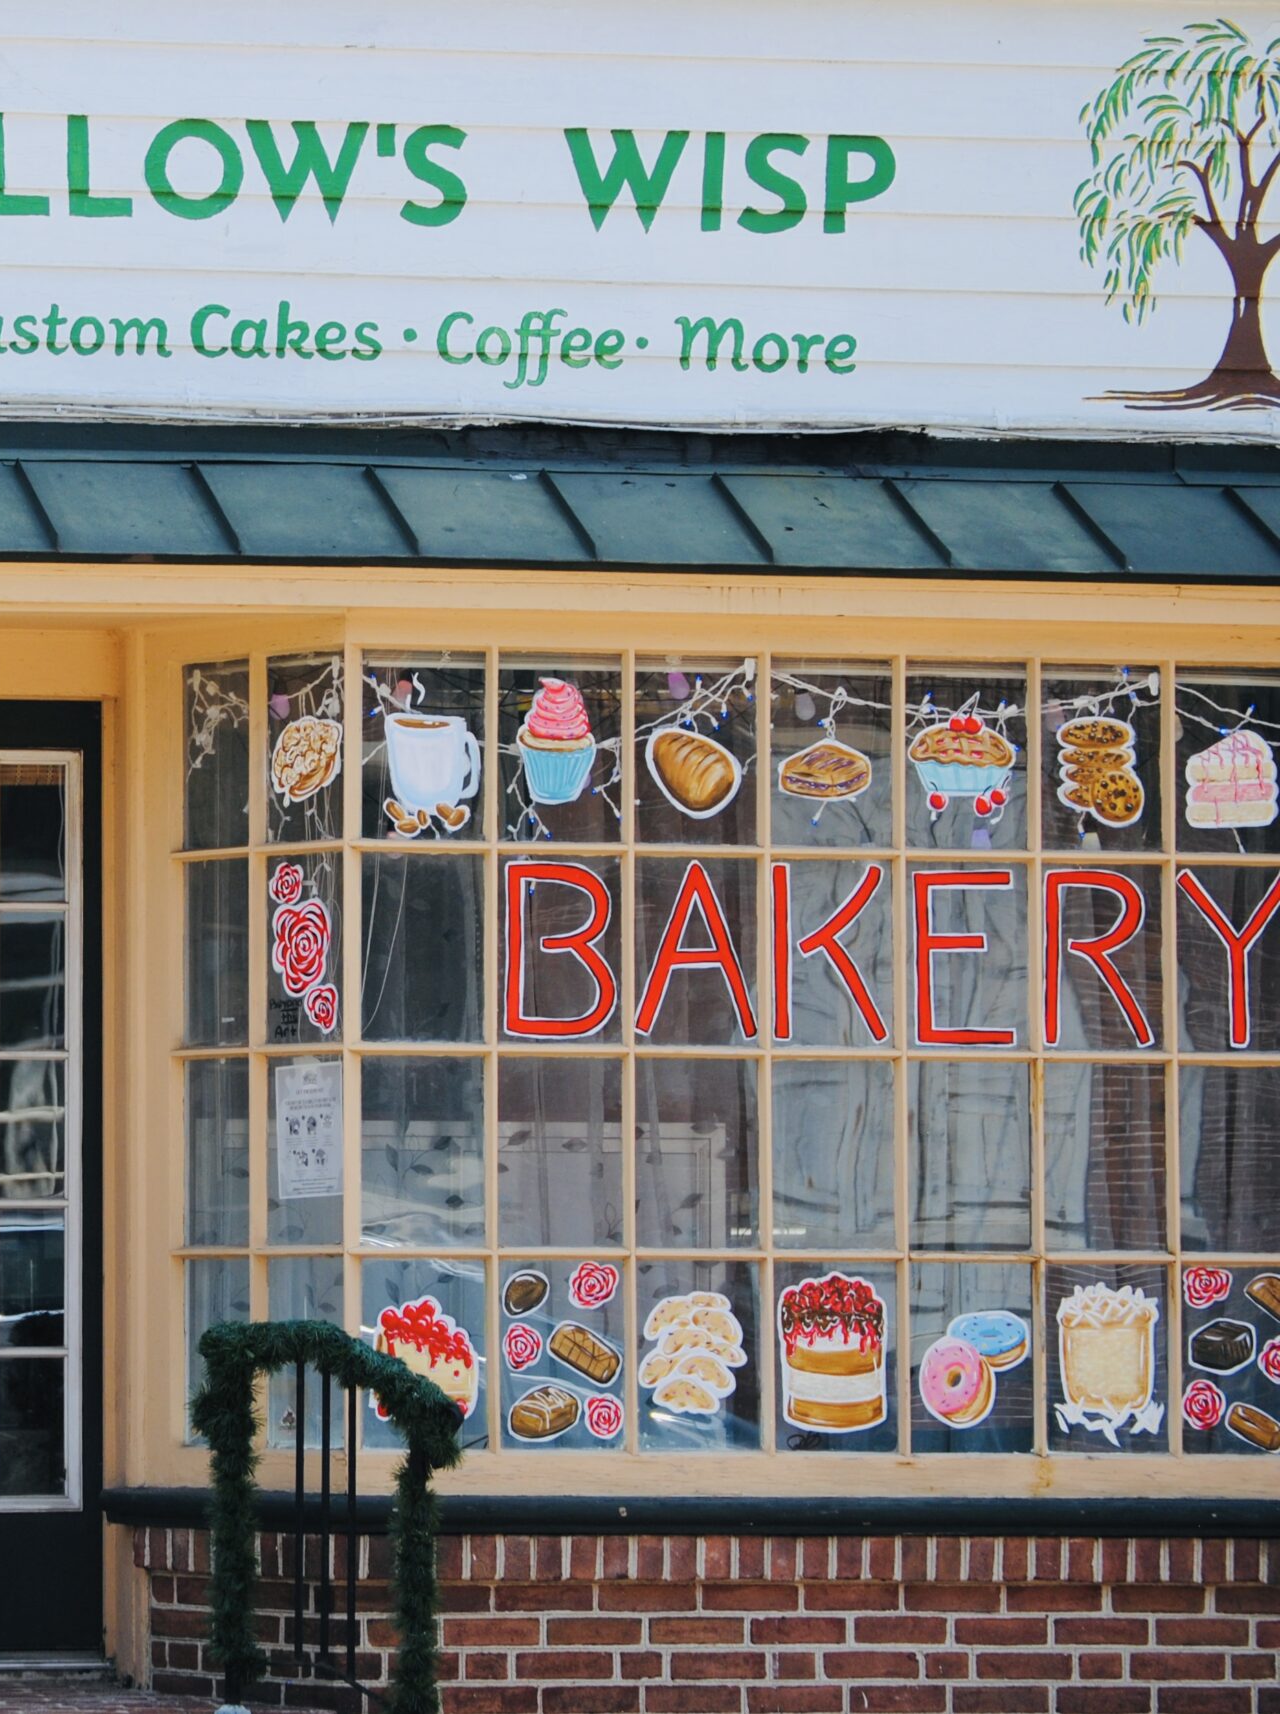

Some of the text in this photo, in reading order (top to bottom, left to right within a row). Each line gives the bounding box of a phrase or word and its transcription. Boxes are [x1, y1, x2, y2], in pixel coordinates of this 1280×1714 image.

[563, 127, 897, 234] WISP
[189, 301, 382, 361] Cakes
[436, 308, 625, 389] Coffee
[674, 315, 858, 375] More
[505, 860, 1280, 1048] BAKERY
[274, 1025, 298, 1039] Art
